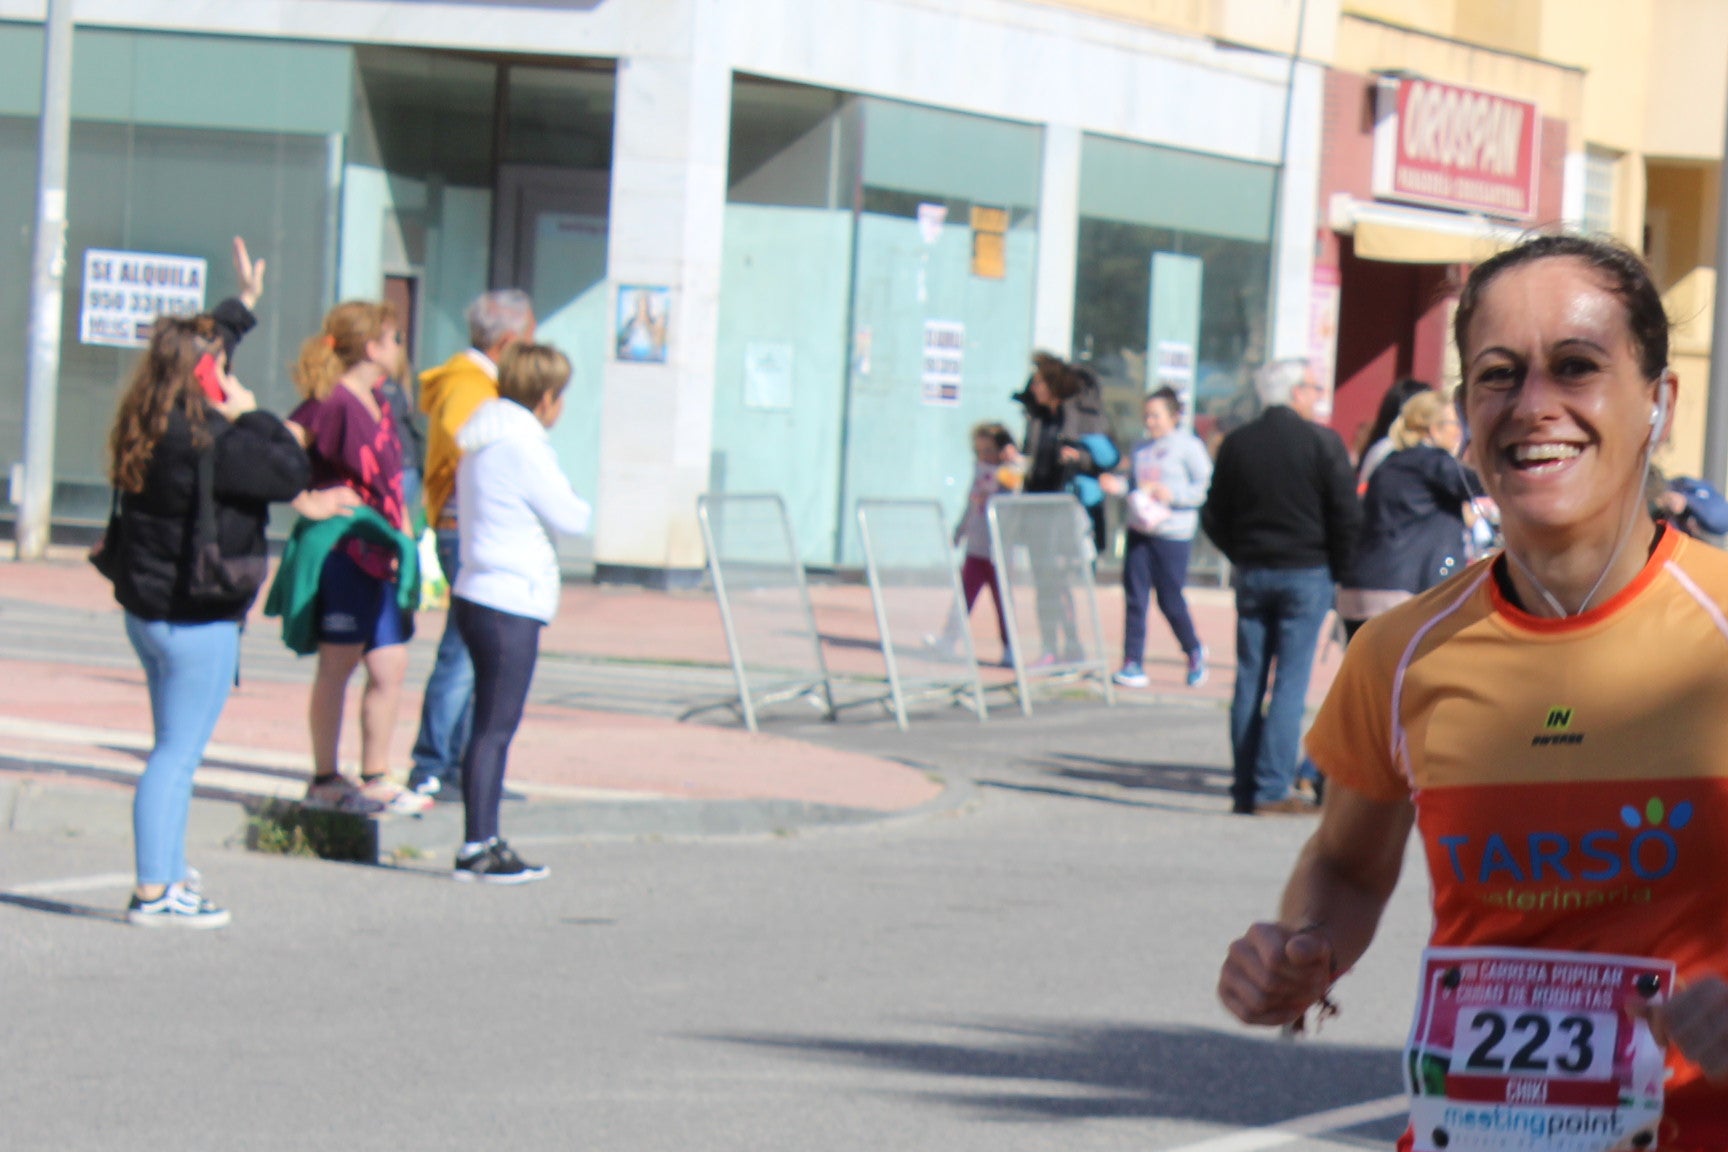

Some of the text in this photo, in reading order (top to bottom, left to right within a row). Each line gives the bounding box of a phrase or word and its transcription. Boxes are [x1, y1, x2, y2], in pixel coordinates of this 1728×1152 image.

[1403, 79, 1524, 178] OROSPAN
[91, 260, 200, 288] SE ALQUILA
[1547, 708, 1572, 728] IN
[1438, 829, 1678, 883] TARSO
[1480, 962, 1548, 983] CARRERA
[1552, 966, 1624, 988] POPULAR
[1508, 986, 1528, 1005] DE
[1465, 1011, 1595, 1073] 223
[1506, 1079, 1548, 1104] CHIKI
